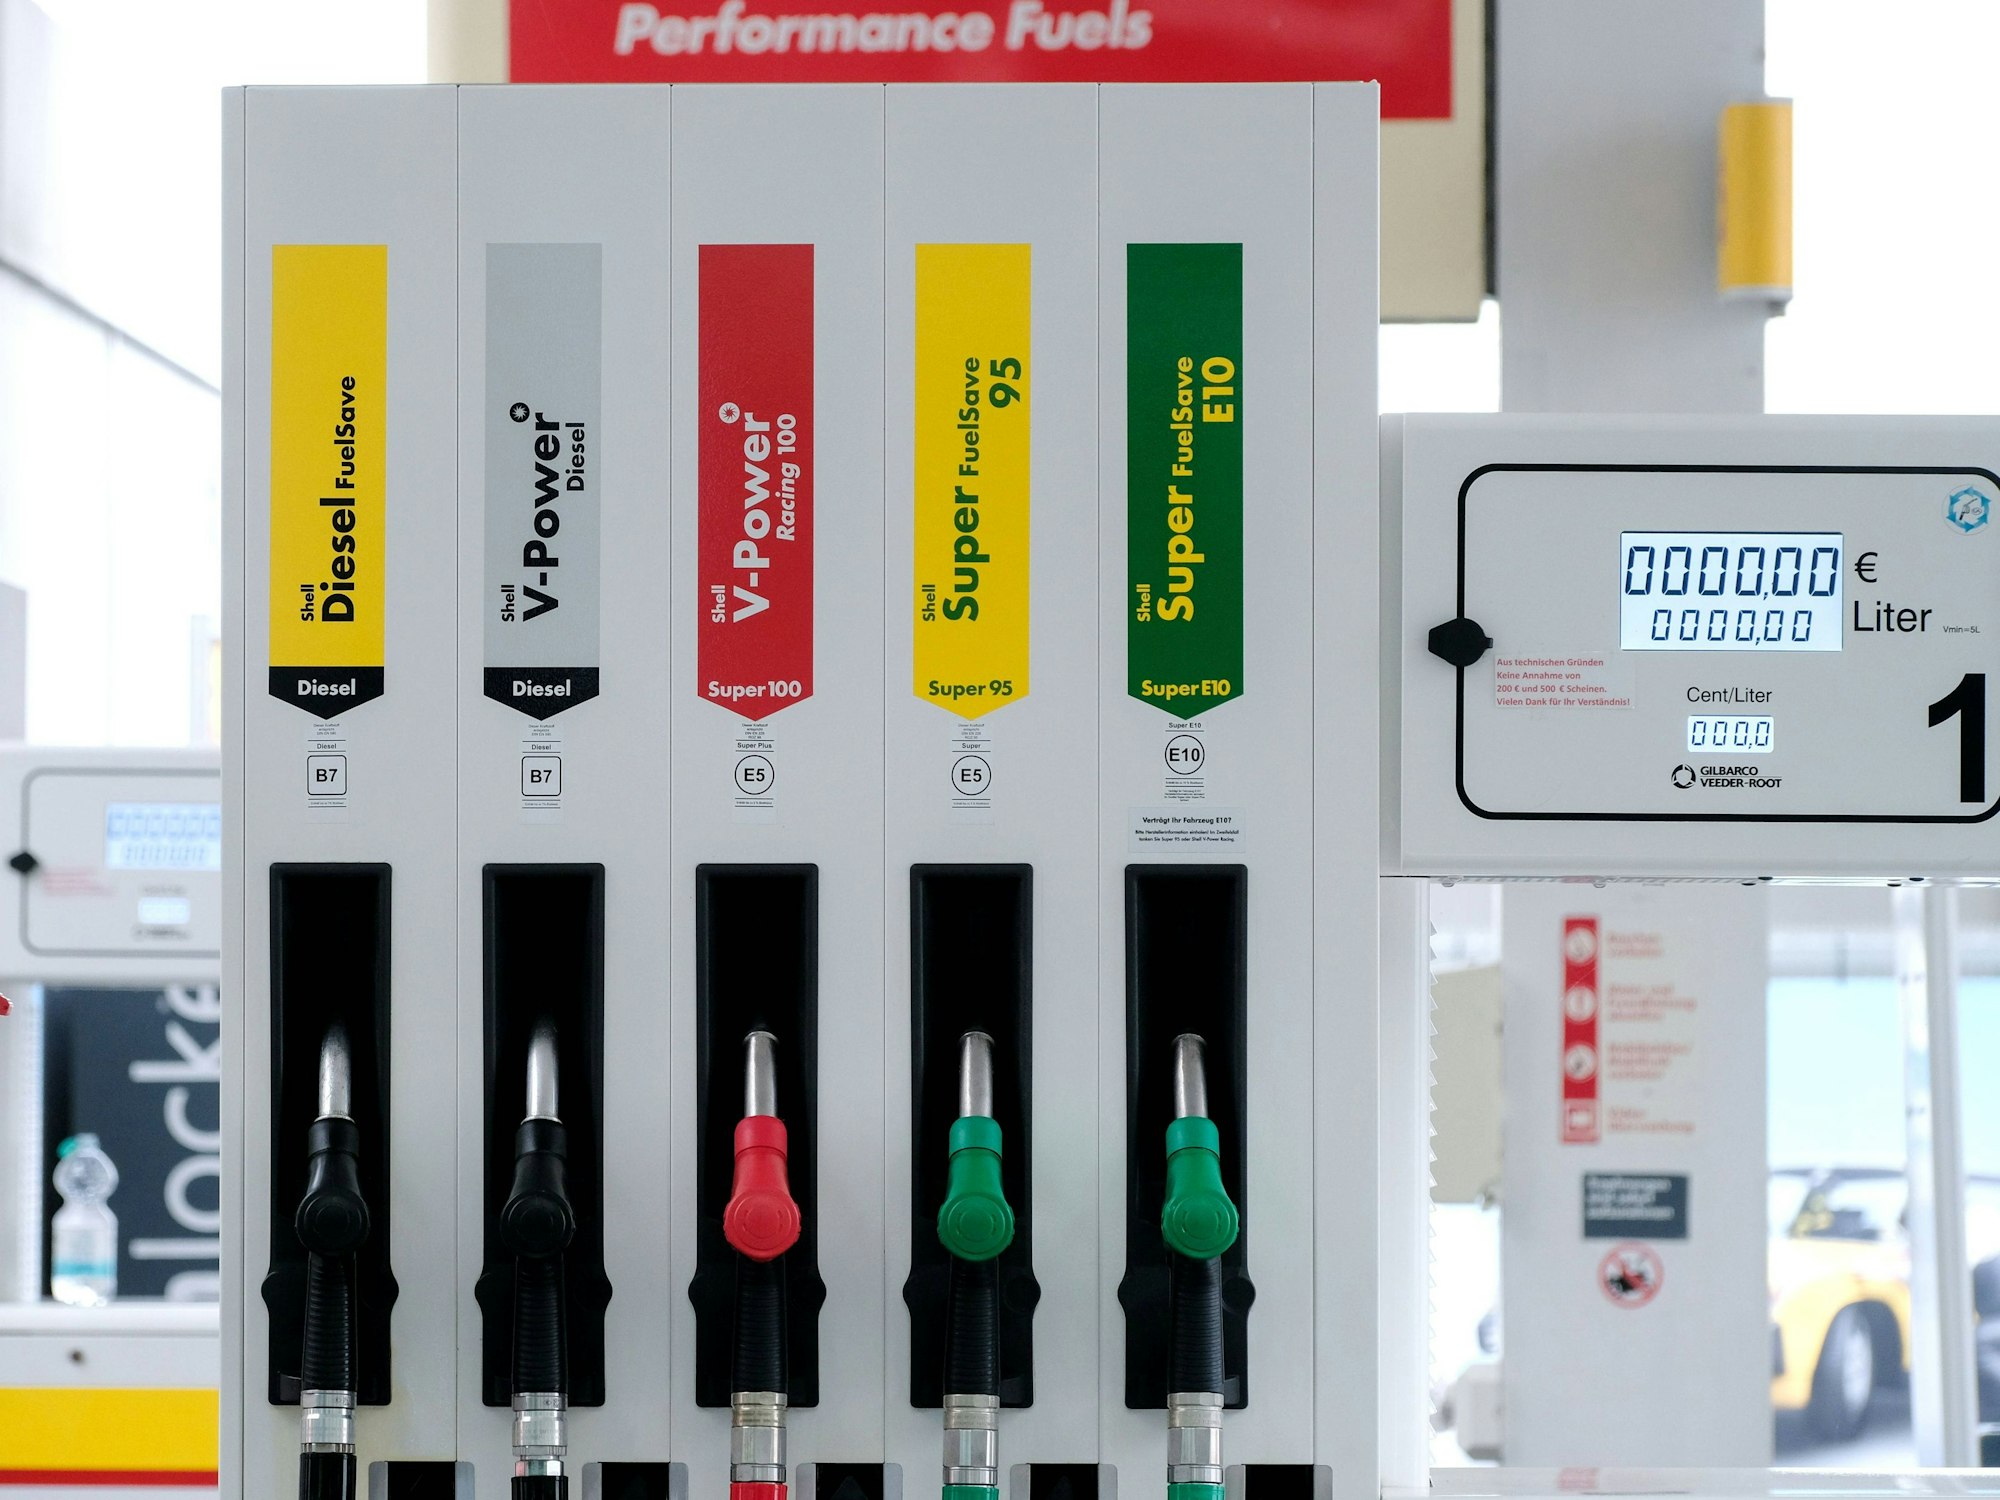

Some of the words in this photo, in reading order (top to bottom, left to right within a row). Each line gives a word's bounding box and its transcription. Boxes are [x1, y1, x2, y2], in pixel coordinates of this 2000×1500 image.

[615, 1, 993, 55] Performance
[1006, 0, 1152, 50] Fuels
[988, 357, 1021, 409] 95
[1202, 356, 1235, 423] E10
[334, 375, 356, 489] FuelSave
[777, 413, 797, 455] 100
[957, 357, 980, 477] FuelSave
[1171, 356, 1194, 477] FuelSave
[565, 422, 586, 491] Diesel
[522, 412, 560, 622] V-Power
[732, 412, 770, 623] V-Power
[775, 462, 800, 541] Racing
[319, 498, 356, 622] Diesel
[942, 486, 990, 622] Super
[1156, 485, 1204, 622] Super
[1854, 551, 1879, 583] €
[301, 584, 315, 622] Shell
[501, 584, 515, 622] Shell
[711, 584, 726, 623] Shell
[922, 584, 936, 622] Shell
[1136, 583, 1150, 622] Shell
[1852, 600, 1933, 633] Liter
[1497, 658, 1512, 666] Aus
[1515, 658, 1565, 666] technischen
[1566, 658, 1604, 666] Gründen
[297, 678, 356, 697] Diesel
[512, 679, 571, 698] Diesel
[928, 680, 986, 700] Super
[988, 680, 1013, 697] 95
[1496, 697, 1523, 706] Vielen
[1525, 697, 1547, 706] Dank
[1563, 697, 1575, 706] Ihr
[1497, 685, 1512, 693] 200
[1522, 685, 1538, 693] und
[1540, 685, 1556, 693] 500
[1566, 685, 1607, 693] Scheinen.
[1687, 687, 1772, 704] Cent/Liter
[1168, 722, 1188, 730] Super
[1928, 673, 1985, 803] 1
[737, 742, 757, 750] Super
[961, 742, 981, 750] Super
[1169, 748, 1201, 762] E10
[316, 768, 338, 782] B7
[530, 769, 552, 783] B7
[744, 768, 766, 782] E5
[961, 768, 983, 783] E5
[1700, 766, 1759, 775] GILBARCO
[1700, 778, 1783, 788] VEEDER-ROOT
